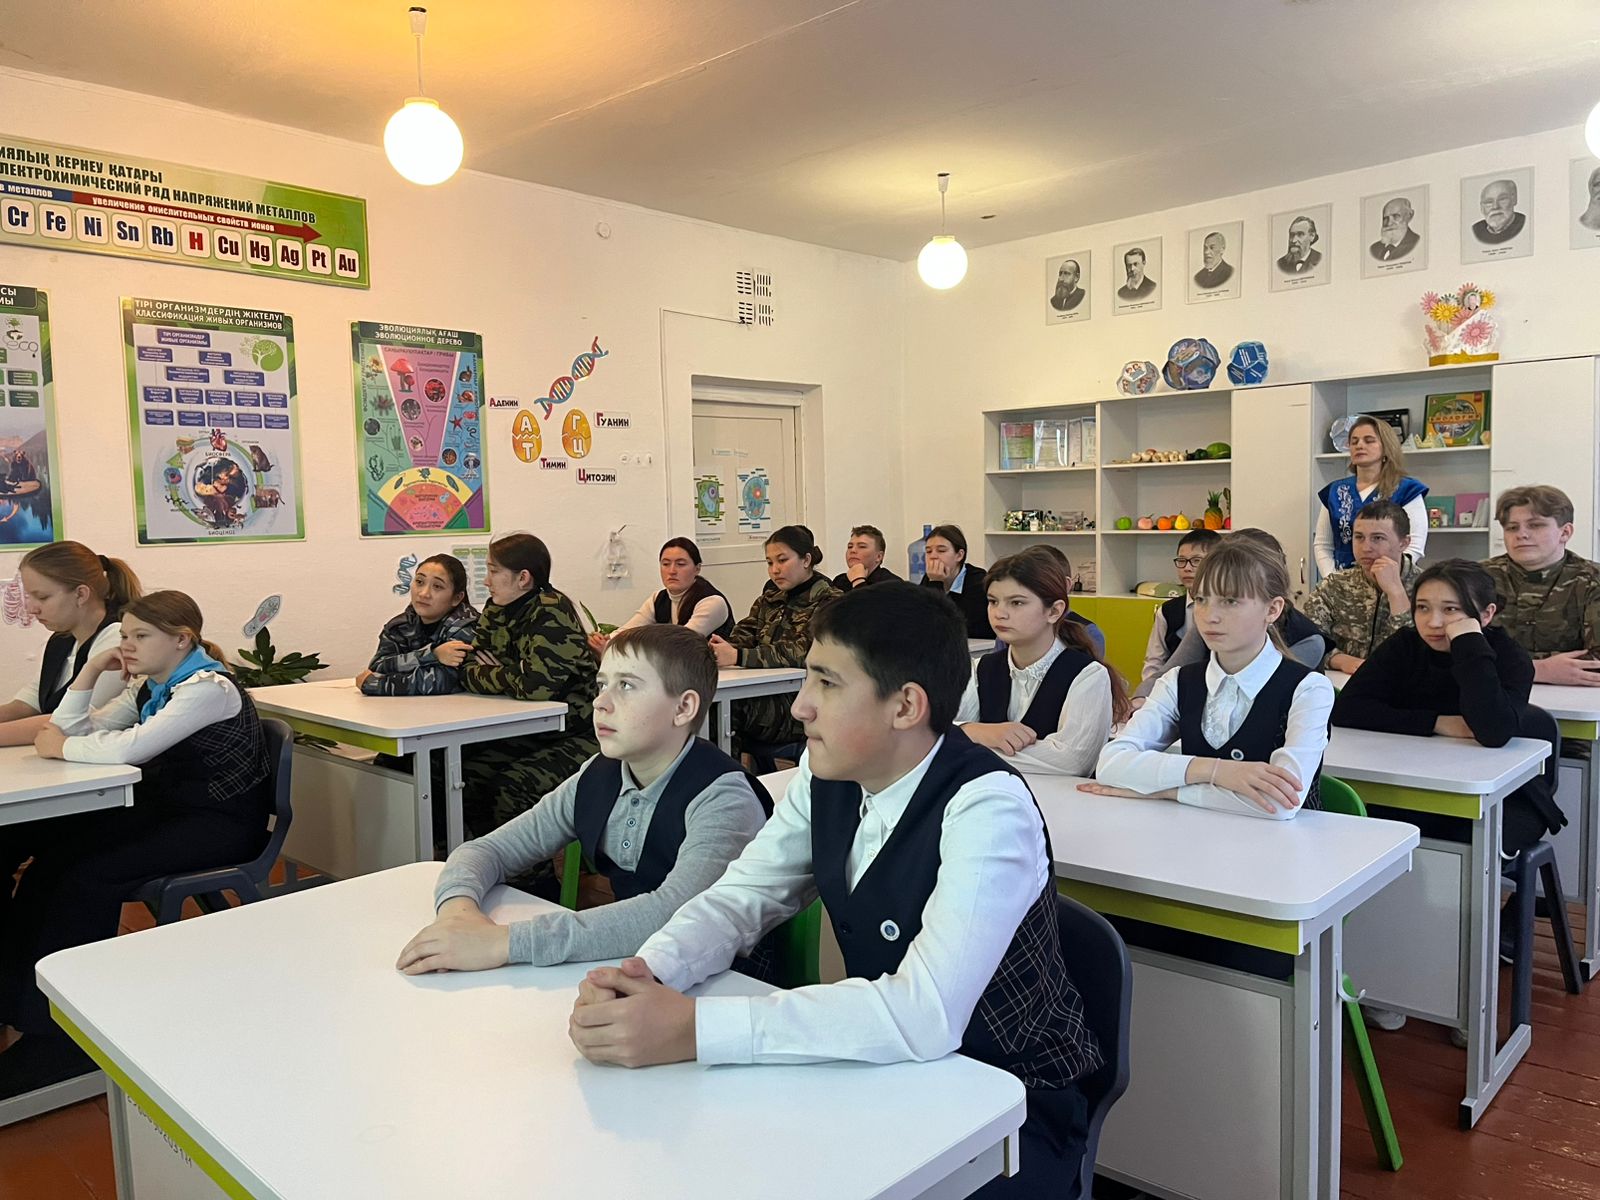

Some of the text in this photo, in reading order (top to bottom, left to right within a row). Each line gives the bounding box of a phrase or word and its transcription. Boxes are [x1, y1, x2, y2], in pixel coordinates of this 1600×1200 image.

[56, 155, 103, 173] КЕРНЕУ
[109, 164, 162, 183] ҚАТАРЫ
[8, 185, 53, 198] металлов
[144, 185, 170, 201] РЯД
[173, 189, 254, 214] НАПРЯЖЕНИЙ
[256, 203, 316, 223] МЕТАЛЛОВ
[92, 197, 275, 232] увеличение окислительных свойств ионов
[7, 205, 357, 273] Cr Fe Ni Sn Rb H Cu Hg Ag Pt Au
[135, 300, 283, 322] ТІРІ ОРГАНИЗМДЕРДІҢ ЖІКТЕЛУІ
[135, 309, 283, 330] КЛАССИФИКАЦИЯ ЖИВЫХ ОРГАНИЗМОВ
[375, 331, 462, 346] ЭВОЛЮЦИОННОЕ ДЕРЕВО
[379, 324, 437, 336] ЭВОЛЮЦИЯЛЫҚ
[521, 416, 533, 432] А
[573, 414, 581, 431] Г
[522, 442, 534, 460] Т
[573, 438, 584, 456] Ц
